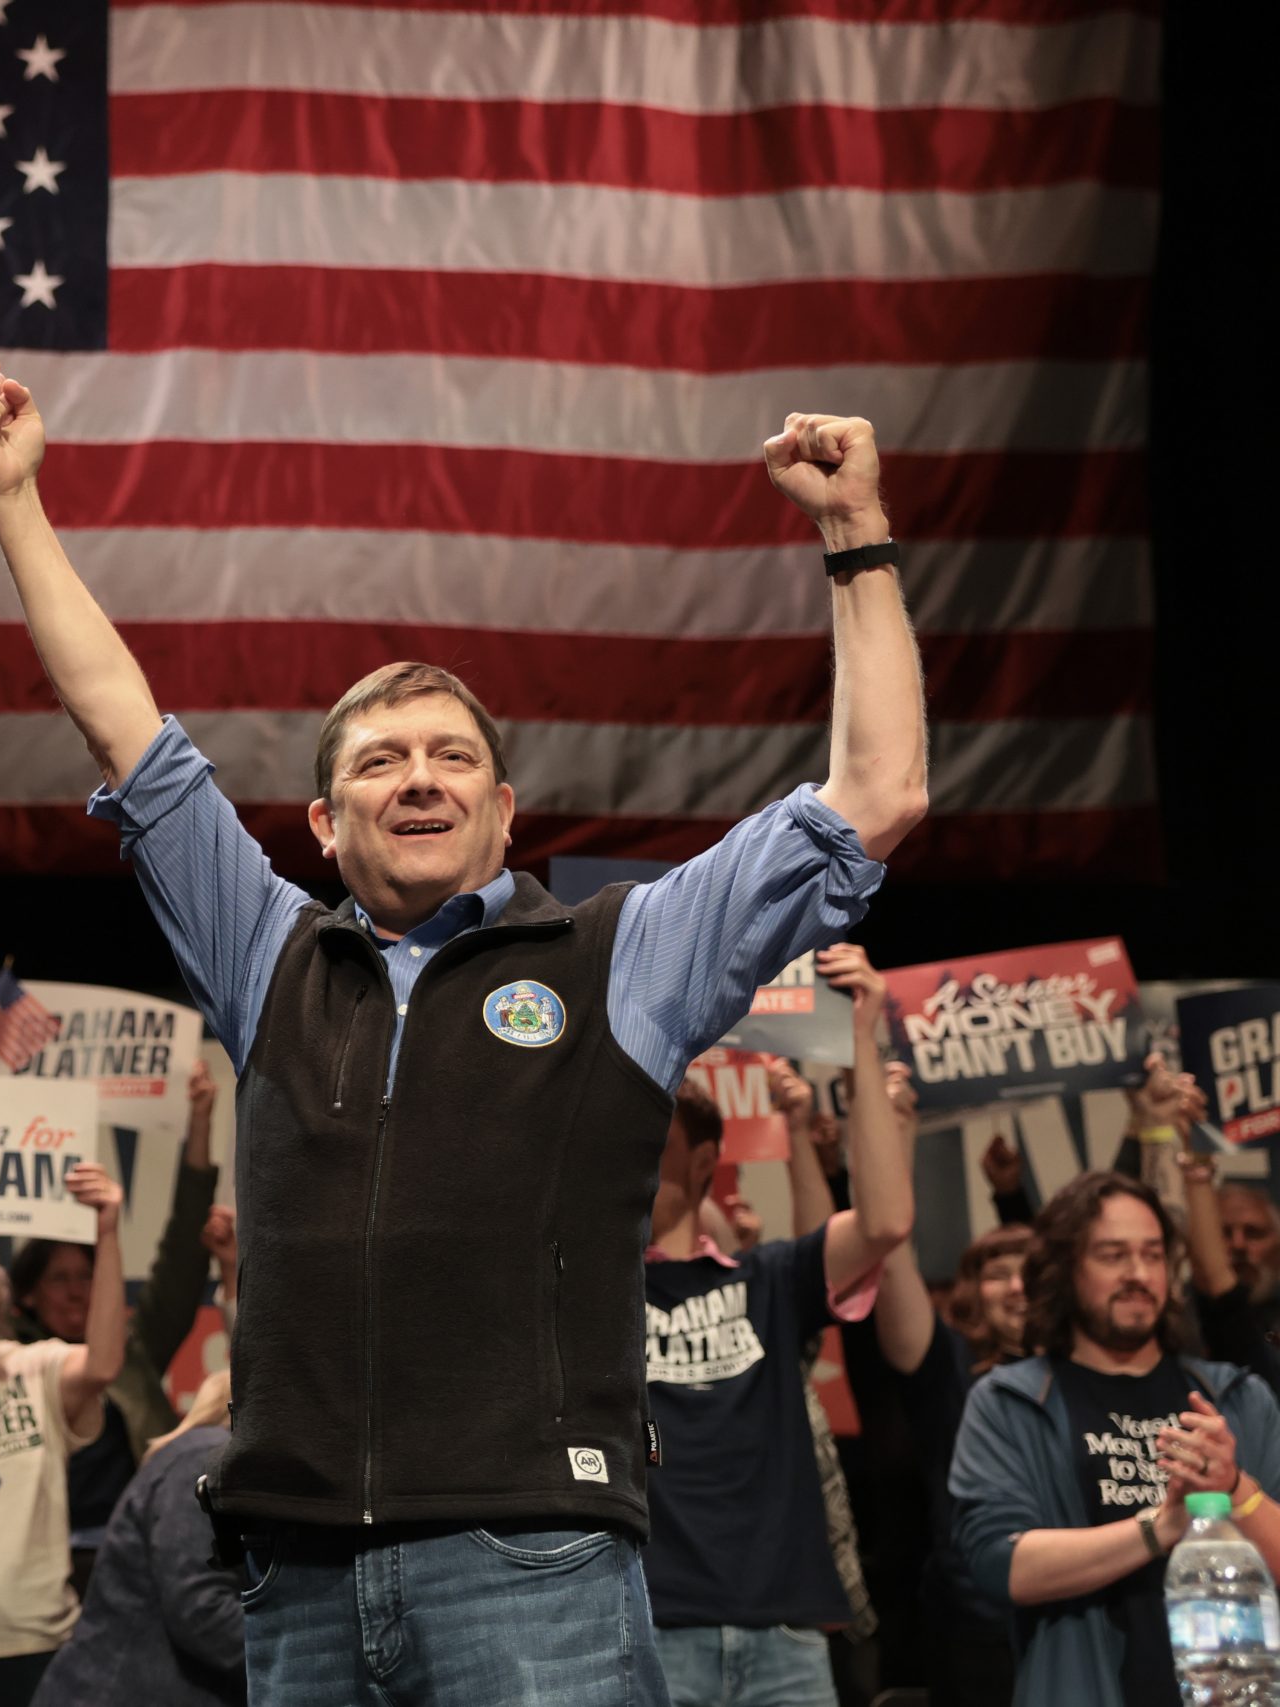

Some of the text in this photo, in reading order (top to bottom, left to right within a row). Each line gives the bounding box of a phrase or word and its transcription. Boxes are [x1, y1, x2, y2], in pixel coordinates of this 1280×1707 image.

[903, 988, 1118, 1043] MONEY
[913, 1017, 1127, 1084] CAN'T BUY
[19, 1115, 78, 1149] for
